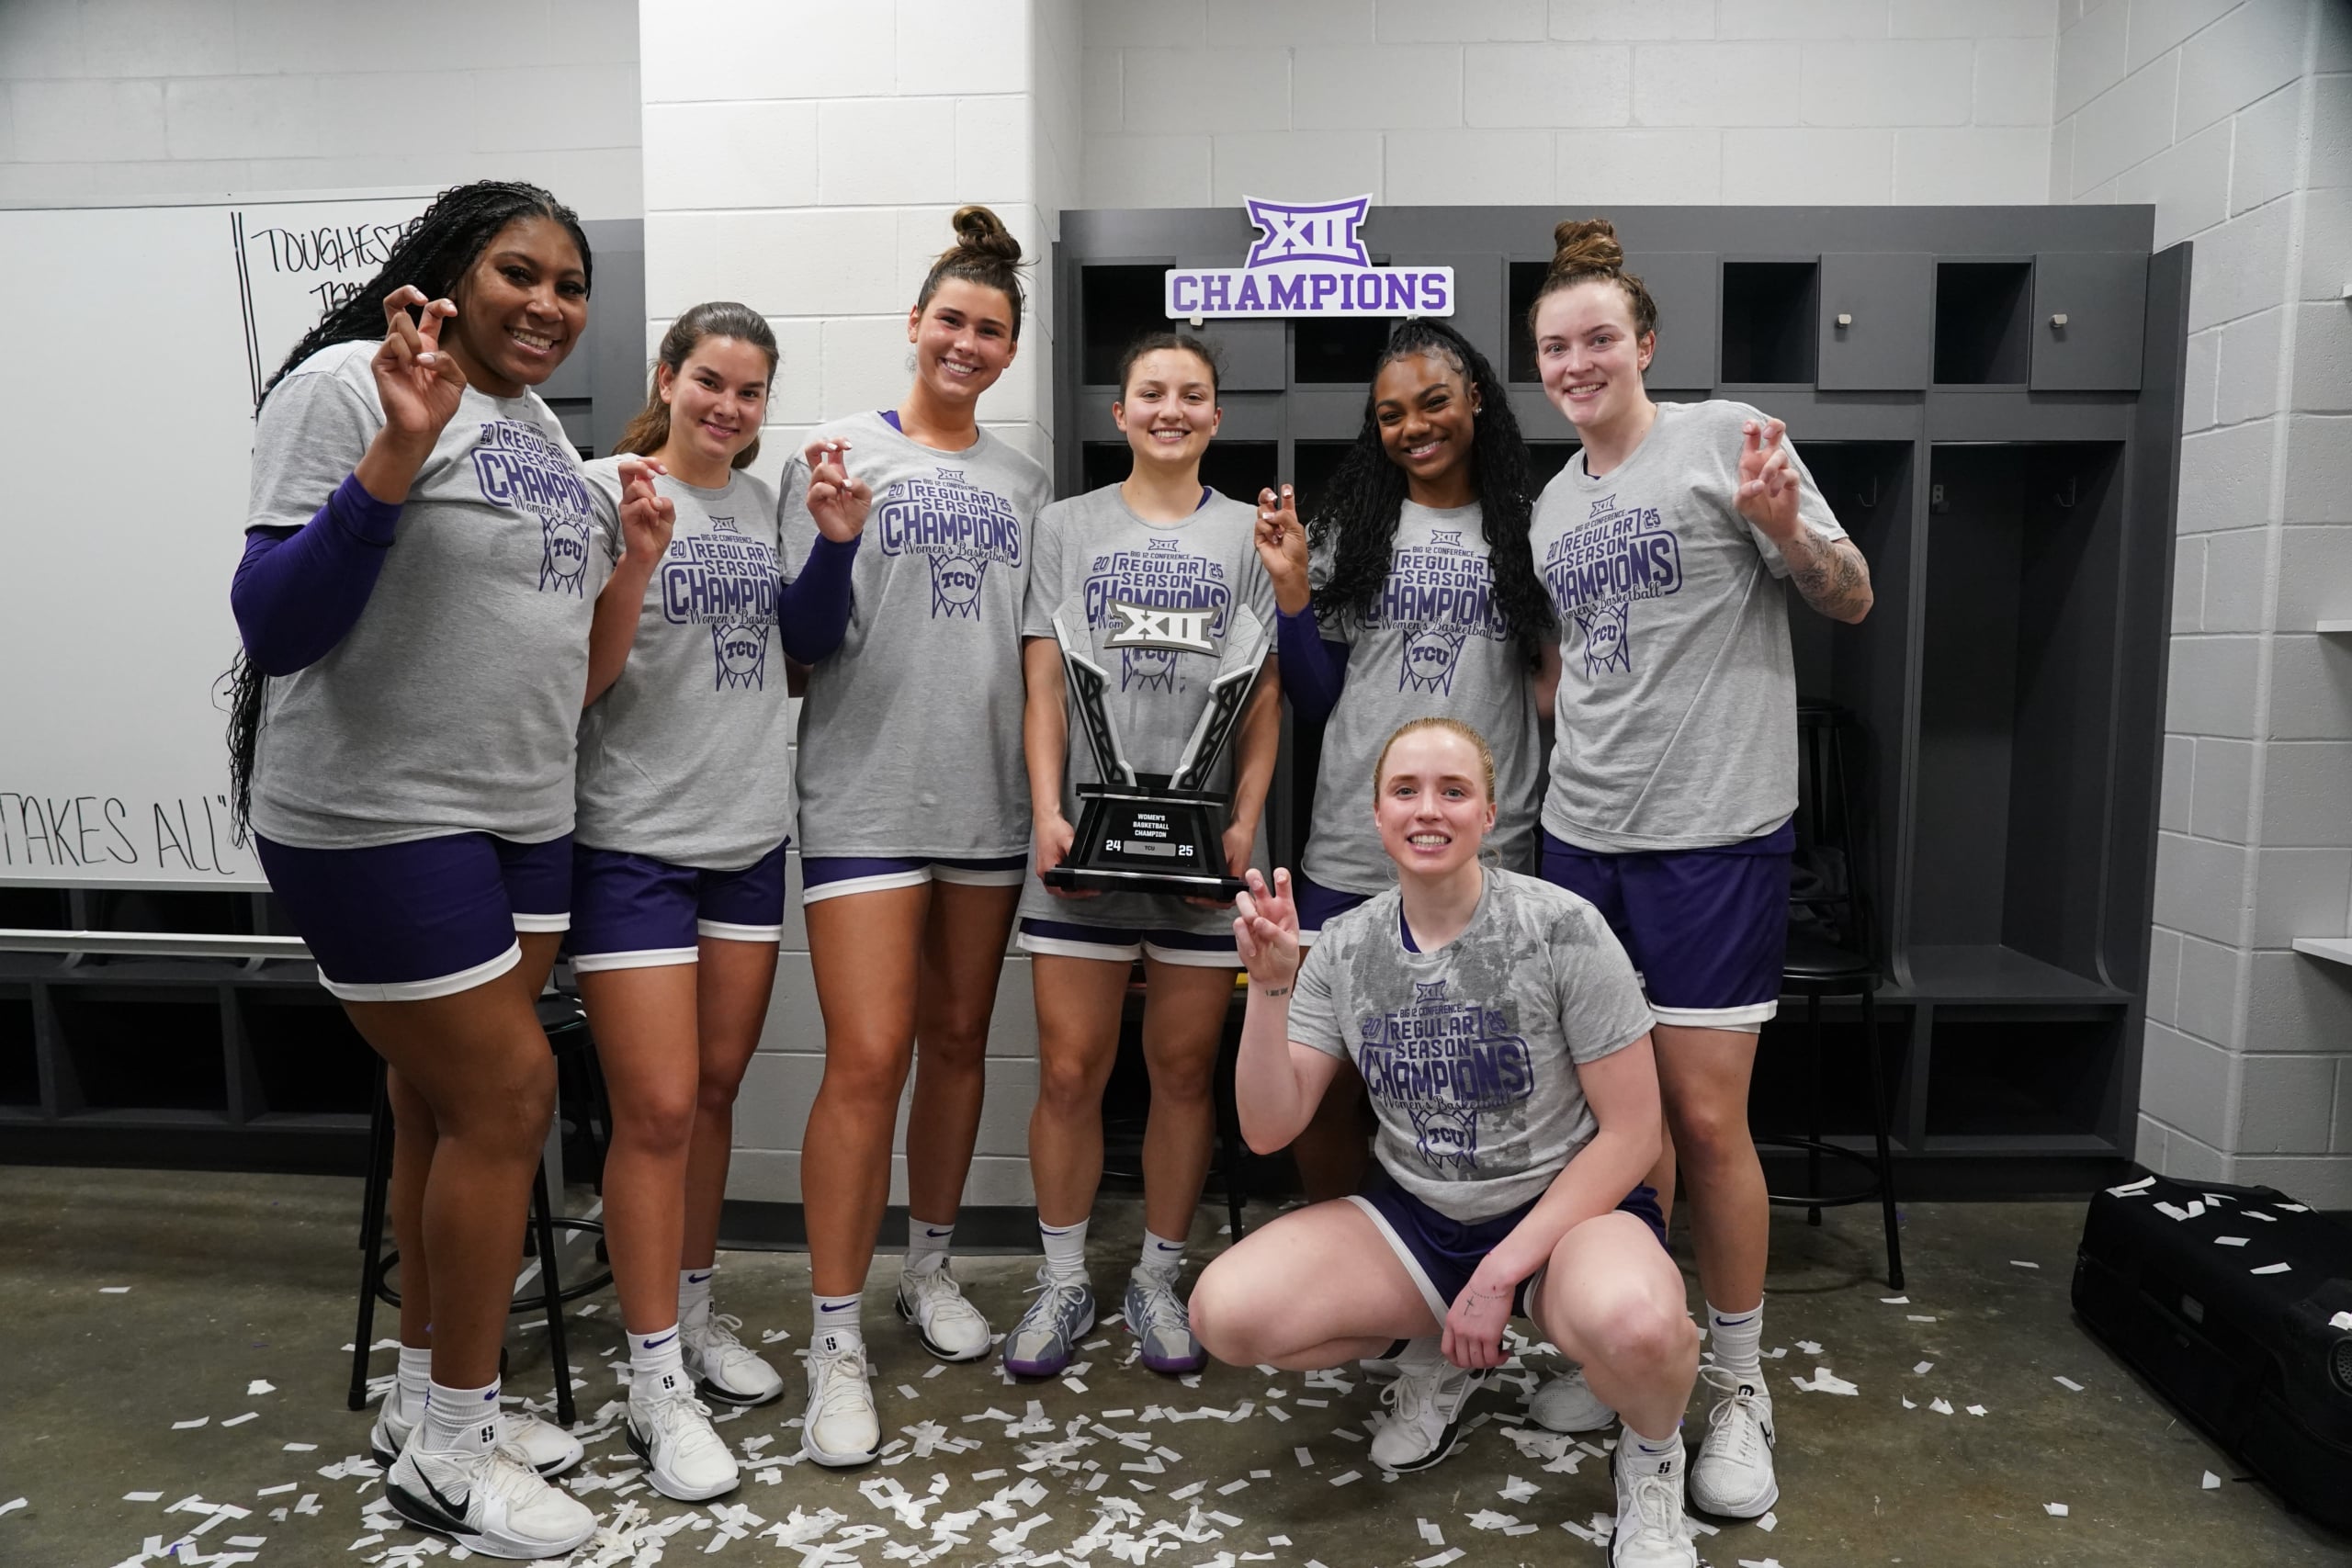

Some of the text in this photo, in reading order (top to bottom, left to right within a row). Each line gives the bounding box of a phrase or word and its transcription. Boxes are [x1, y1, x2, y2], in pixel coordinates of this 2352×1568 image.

[1173, 274, 1446, 311] CHAMPIONS
[888, 484, 905, 498] 20
[915, 486, 991, 506] REGULAR
[922, 498, 989, 517] SEASON
[1590, 510, 1625, 528] CONFERENCE
[719, 536, 753, 544] CONFERENCE
[885, 505, 1019, 560] CHAMPIONS
[1564, 516, 1633, 553] REGULAR
[553, 538, 582, 561] TCU
[671, 540, 686, 558] 20
[695, 544, 767, 561] REGULAR
[900, 540, 1012, 566] Women's Basketball
[1433, 547, 1475, 558] CONFERENCE
[1566, 536, 1627, 569] SEASON
[707, 560, 768, 578] SEASON
[1092, 557, 1111, 571] 20
[1118, 558, 1199, 575] REGULAR
[1401, 555, 1484, 575] REGULAR
[942, 571, 977, 590] TCU
[1121, 572, 1193, 589] SEASON
[1403, 570, 1477, 589] SEASON
[1547, 537, 1674, 615] CHAMPIONS
[669, 569, 781, 615] CHAMPION
[1599, 581, 1663, 610] Basketball
[686, 608, 779, 626] Women's Basketb
[1379, 615, 1496, 640] Women's Basketball
[1592, 625, 1617, 647] TCU
[725, 641, 758, 660] TCU
[1412, 646, 1449, 665] TCU
[1133, 821, 1170, 830] BASKETBALL
[1137, 813, 1166, 822] WOMEN'S
[0, 793, 138, 866] TAKES
[1135, 829, 1167, 838] CHAMPION
[1105, 840, 1121, 852] 24
[1178, 844, 1193, 856] 25
[1419, 1004, 1463, 1017] CONFERENCE
[1391, 1016, 1475, 1040] REGULAR
[1396, 1038, 1470, 1059] SEASON
[1364, 1044, 1525, 1100] CHAMPIONS
[1380, 1091, 1433, 1111] Women's
[1428, 1127, 1465, 1148] TCU
